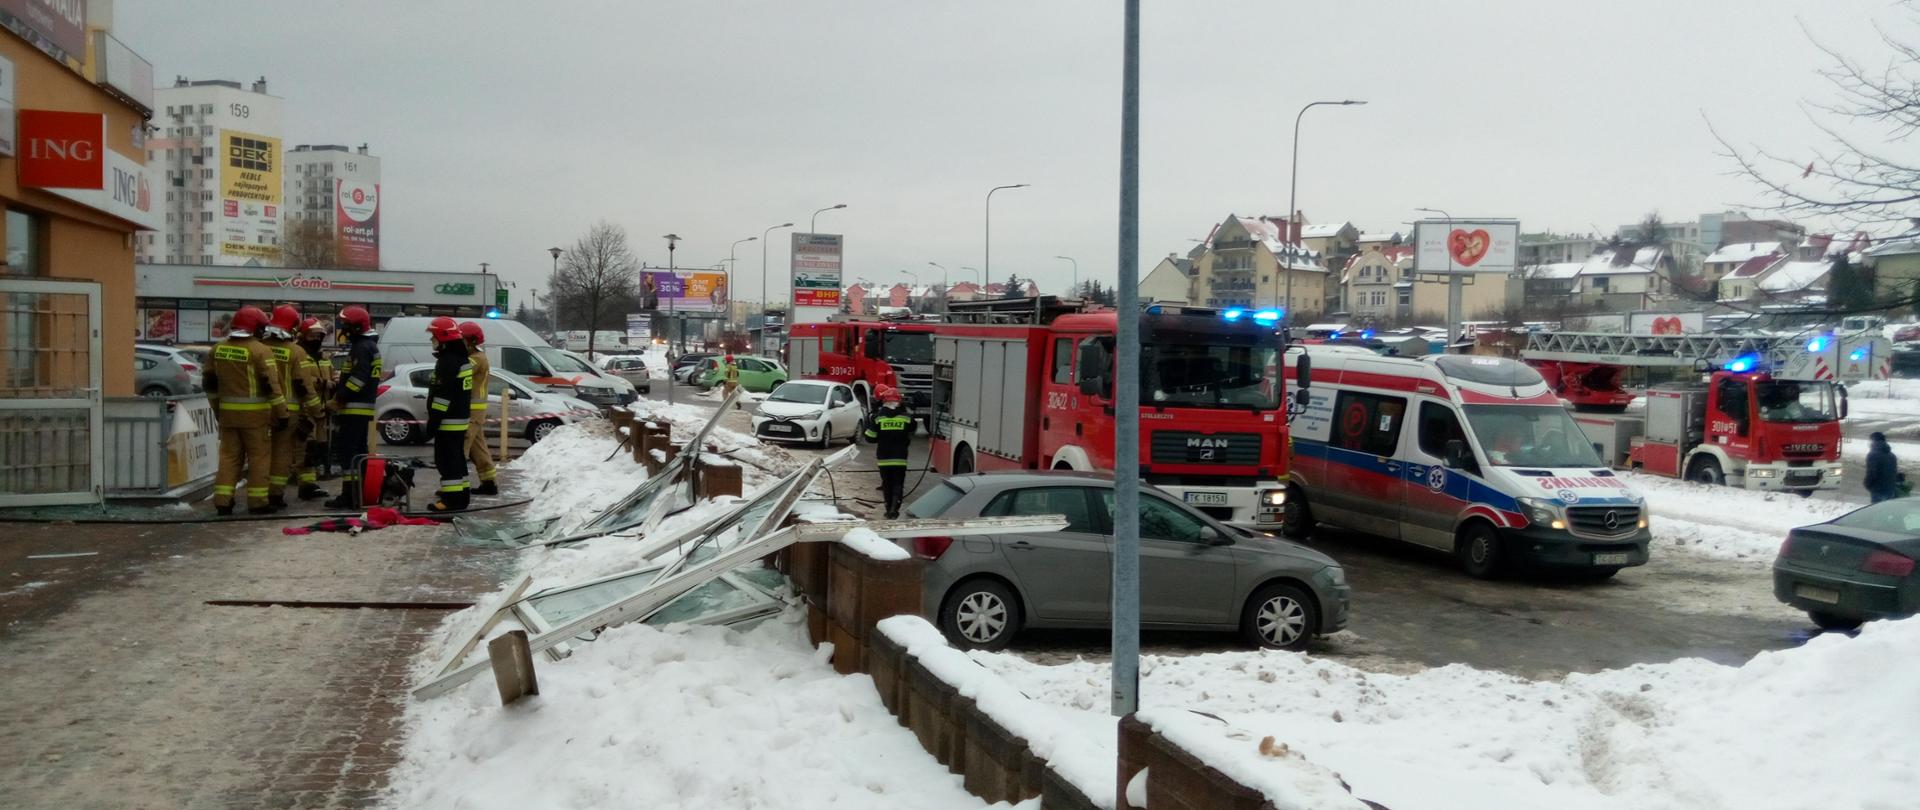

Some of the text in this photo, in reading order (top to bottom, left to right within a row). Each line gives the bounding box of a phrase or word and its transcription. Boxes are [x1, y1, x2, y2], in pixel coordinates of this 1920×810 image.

[229, 102, 249, 119] 159
[28, 137, 94, 162] ING
[230, 146, 266, 162] DEK
[344, 161, 357, 172] 161
[113, 166, 136, 207] ING
[291, 276, 330, 289] Gama
[816, 290, 839, 298] BHP
[1187, 438, 1228, 448] MAN
[1791, 444, 1818, 452] IVECO
[1190, 493, 1200, 503] TK
